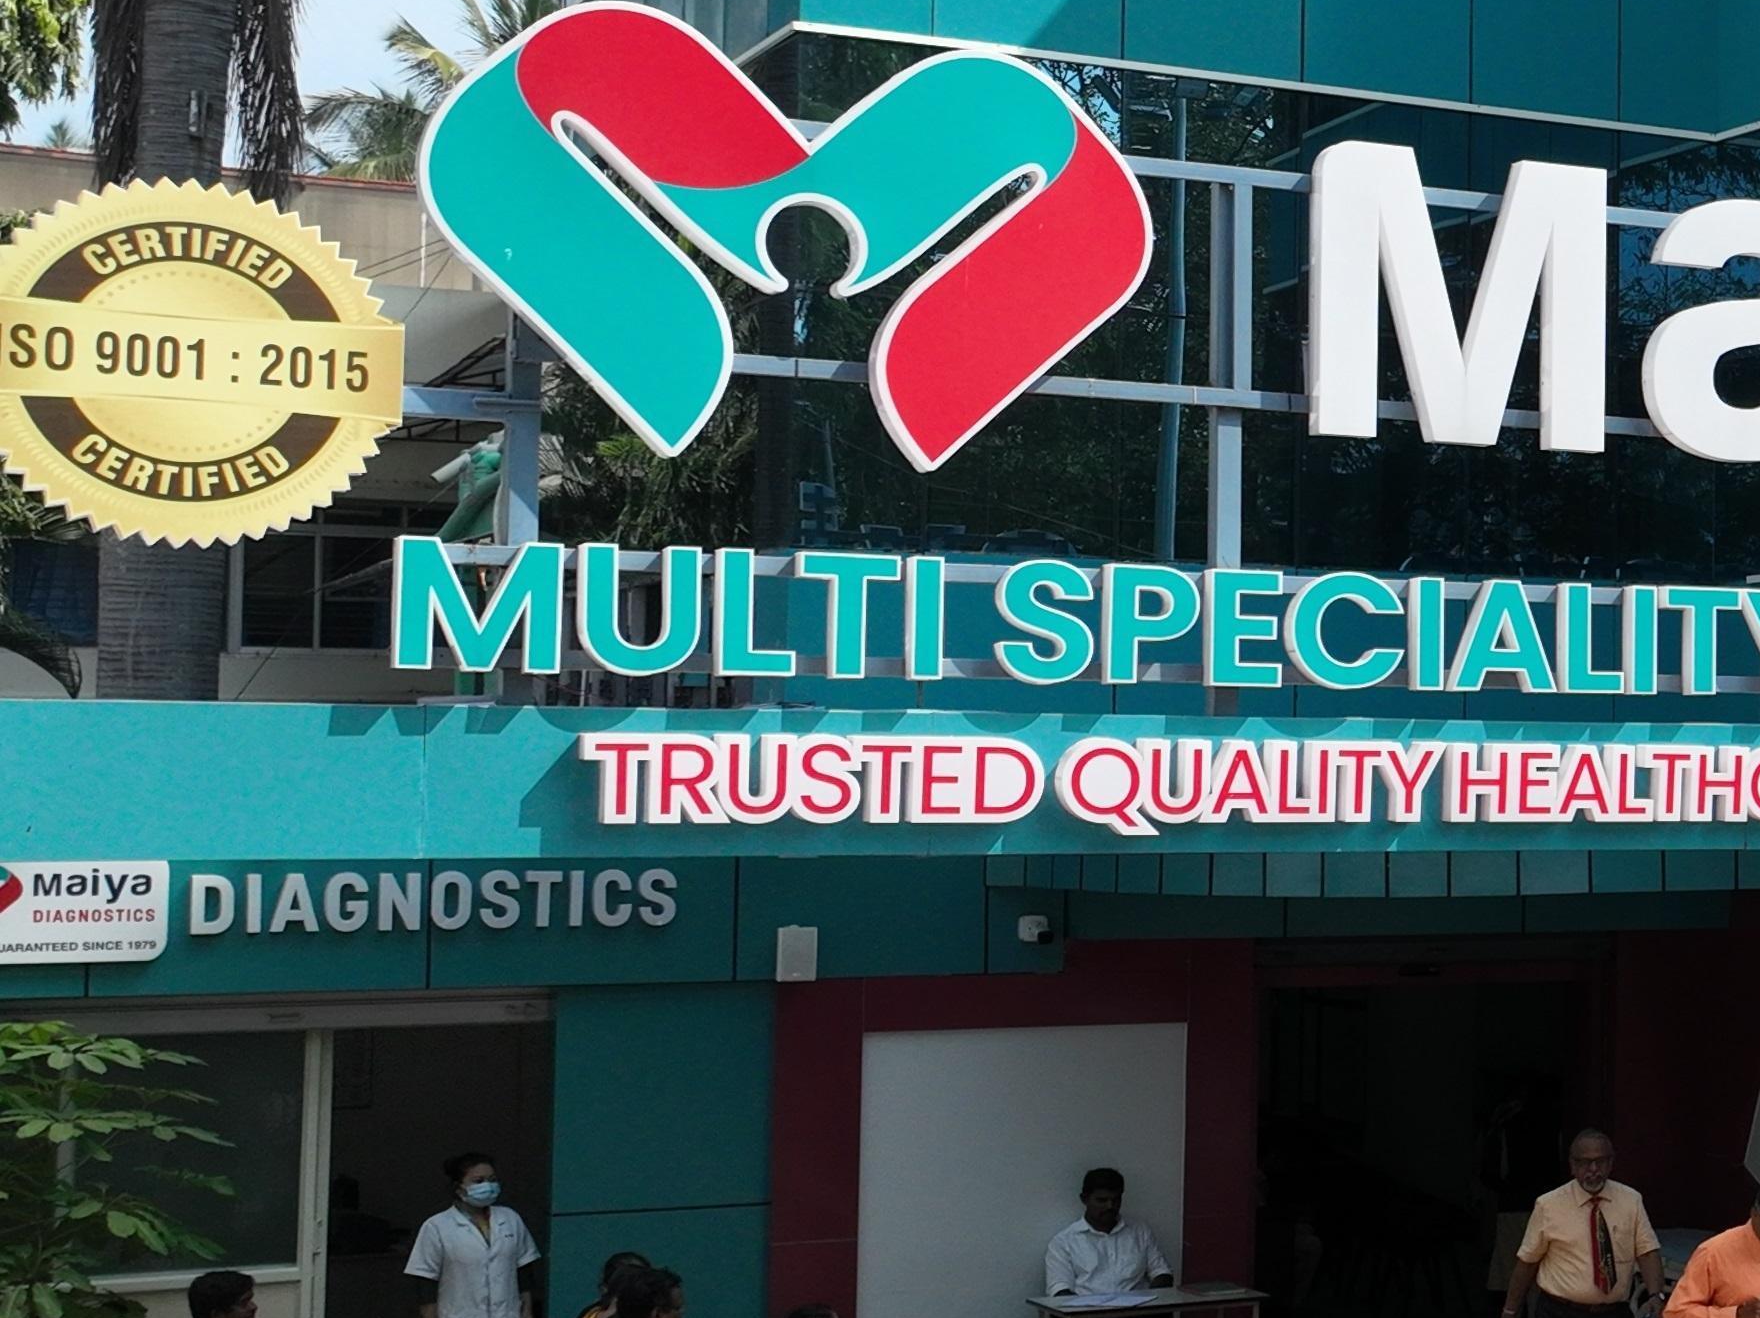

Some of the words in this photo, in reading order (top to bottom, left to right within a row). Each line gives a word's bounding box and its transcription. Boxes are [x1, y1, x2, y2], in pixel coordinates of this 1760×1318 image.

[82, 226, 293, 291] CERTIFIED
[96, 331, 205, 380] 9001
[260, 343, 369, 392] 2015
[72, 434, 290, 497] CERTIFIED
[391, 536, 946, 681] MULTI
[579, 731, 1044, 825] TRUSTED
[1056, 736, 1444, 837] QUALITY
[33, 869, 152, 904] Maiya
[33, 909, 155, 923] DIAGNOSTICS
[189, 868, 678, 935] DIAGNOSTICS
[82, 941, 123, 951] SINCE
[128, 940, 157, 950] 1979
